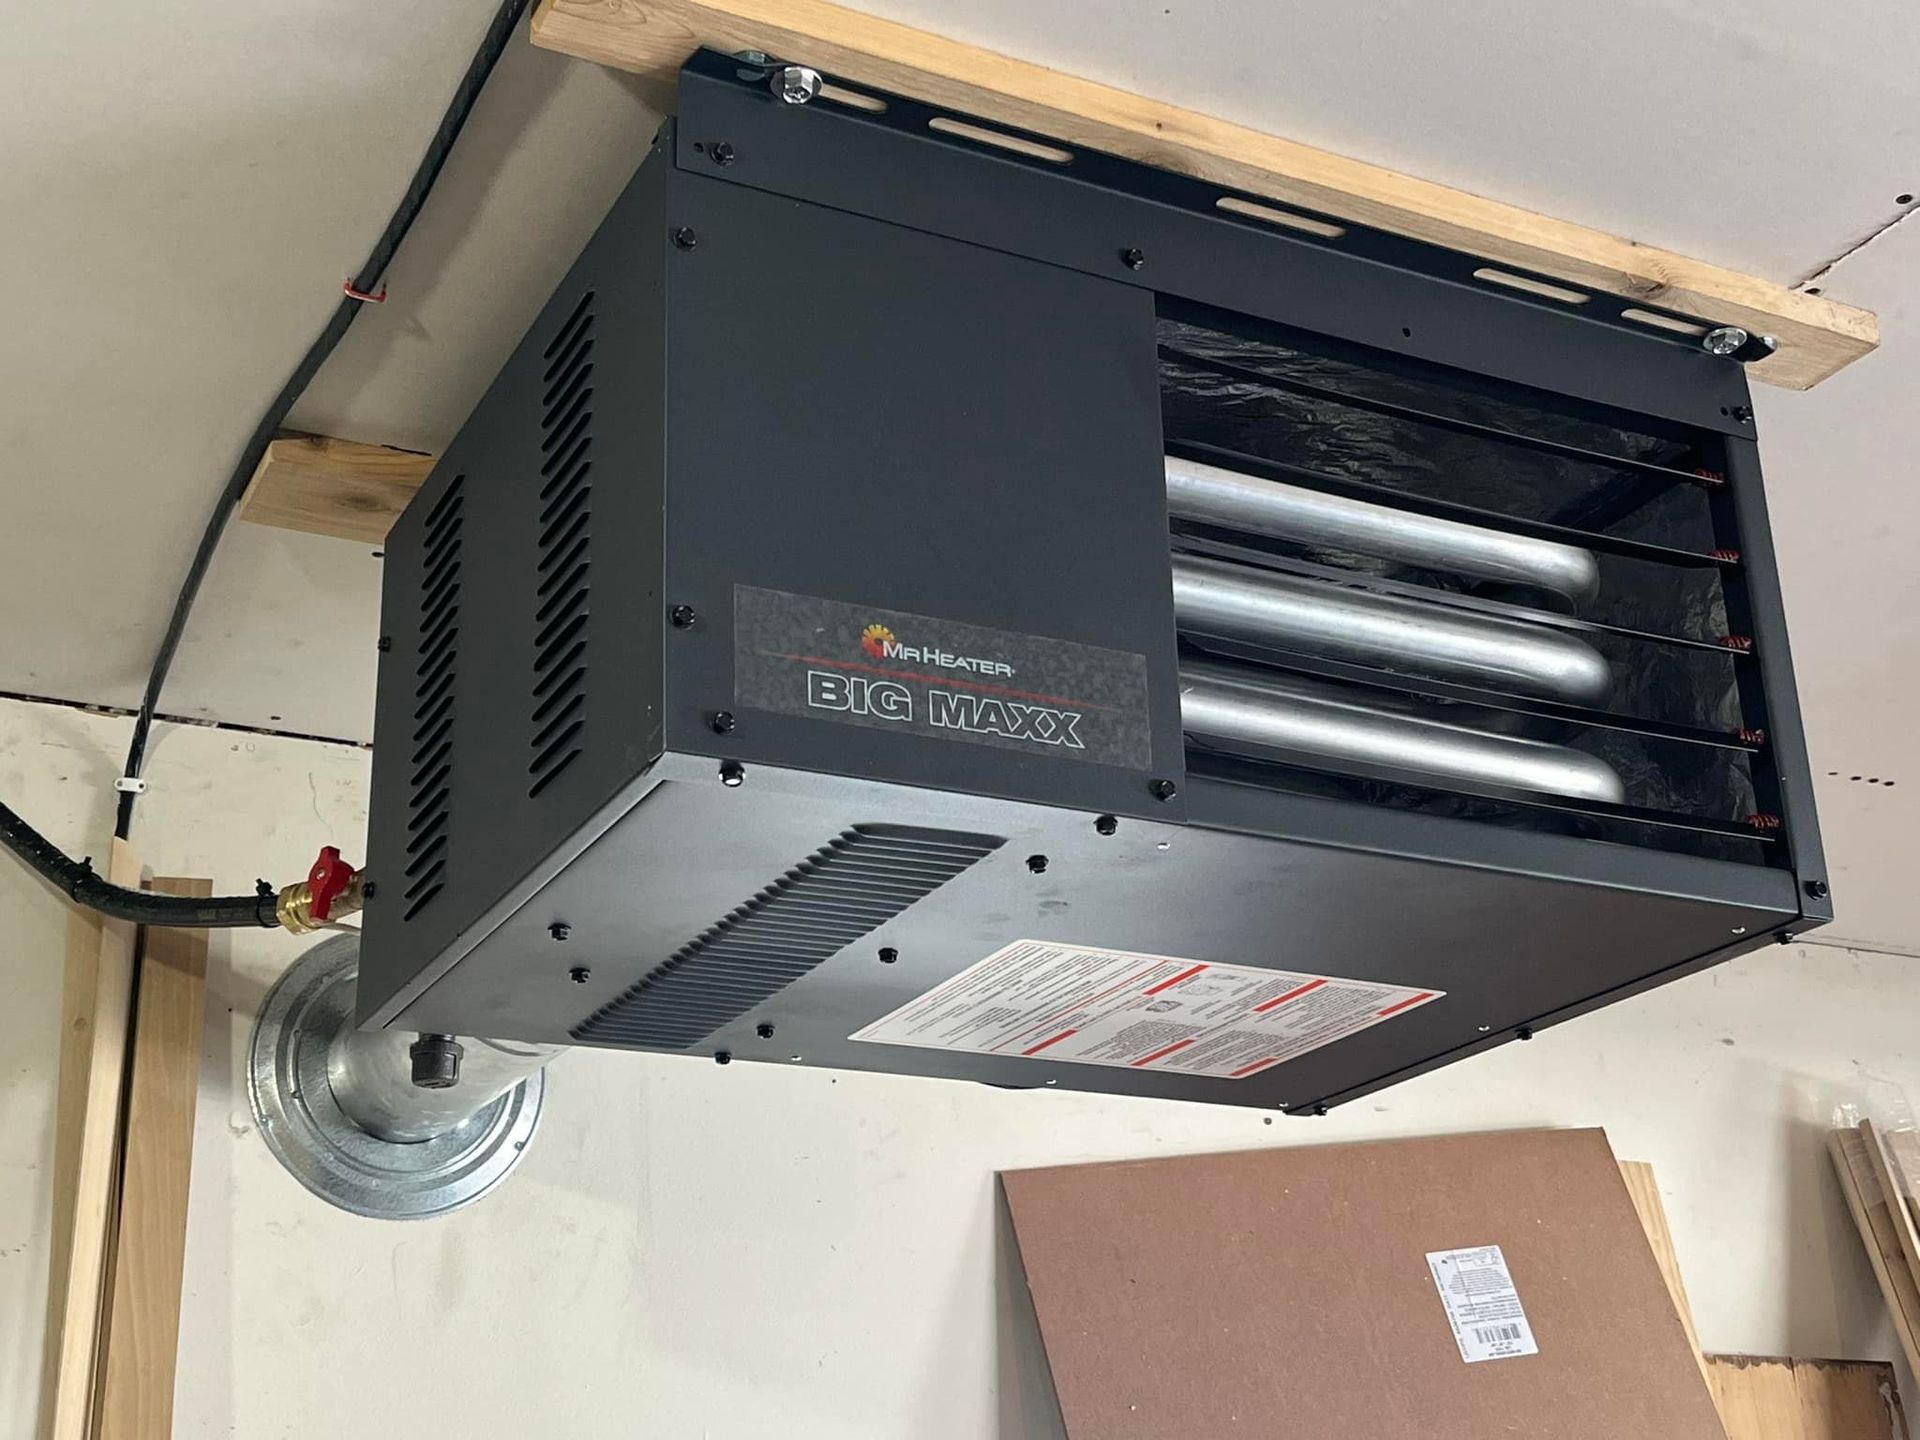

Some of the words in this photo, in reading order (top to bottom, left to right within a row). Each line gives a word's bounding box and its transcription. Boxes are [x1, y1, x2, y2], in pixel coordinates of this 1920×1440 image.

[923, 646, 1012, 677] HEATER
[808, 671, 912, 721] BIG
[929, 690, 1085, 749] MAXX
